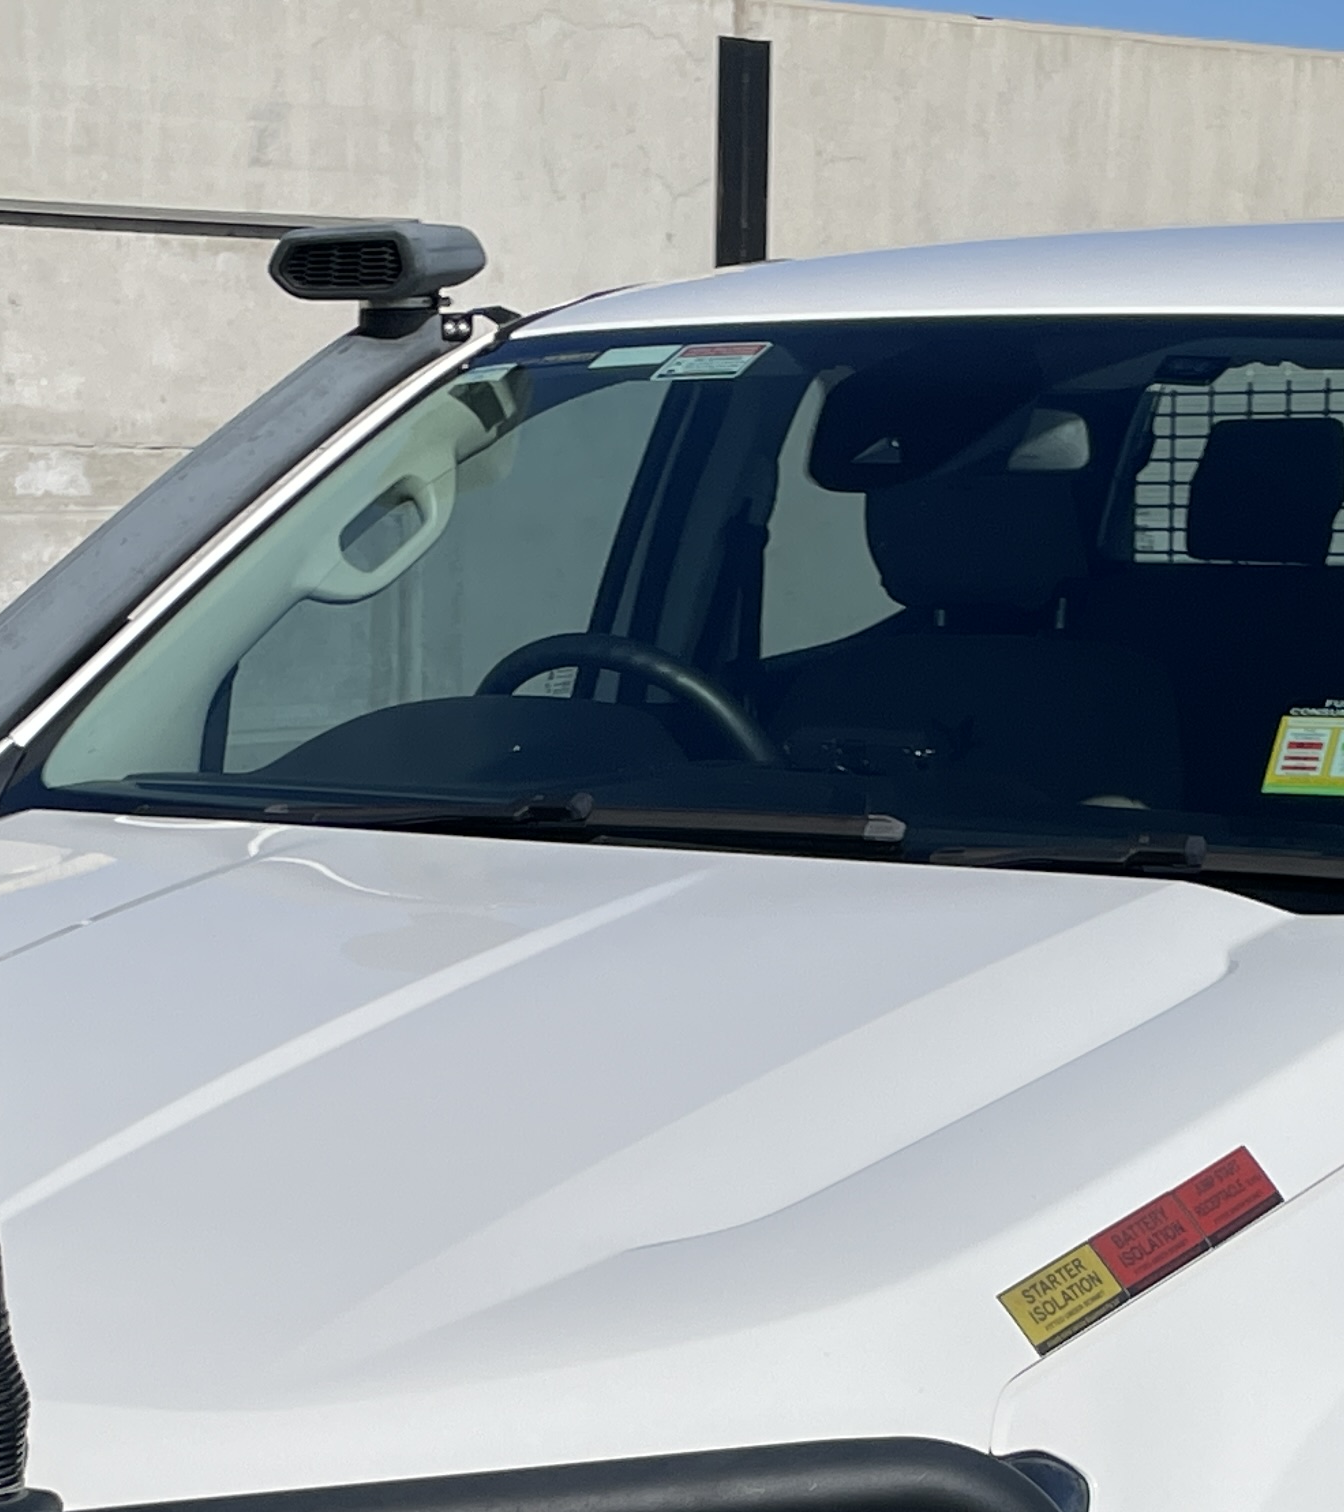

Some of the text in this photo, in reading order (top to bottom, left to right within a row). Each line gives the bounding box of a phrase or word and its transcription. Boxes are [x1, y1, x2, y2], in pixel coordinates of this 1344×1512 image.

[1110, 1206, 1168, 1249] BATTERY
[1119, 1220, 1186, 1268] ISOLATION
[1021, 1258, 1087, 1304] STARTER
[1028, 1270, 1103, 1324] ISOLATION
